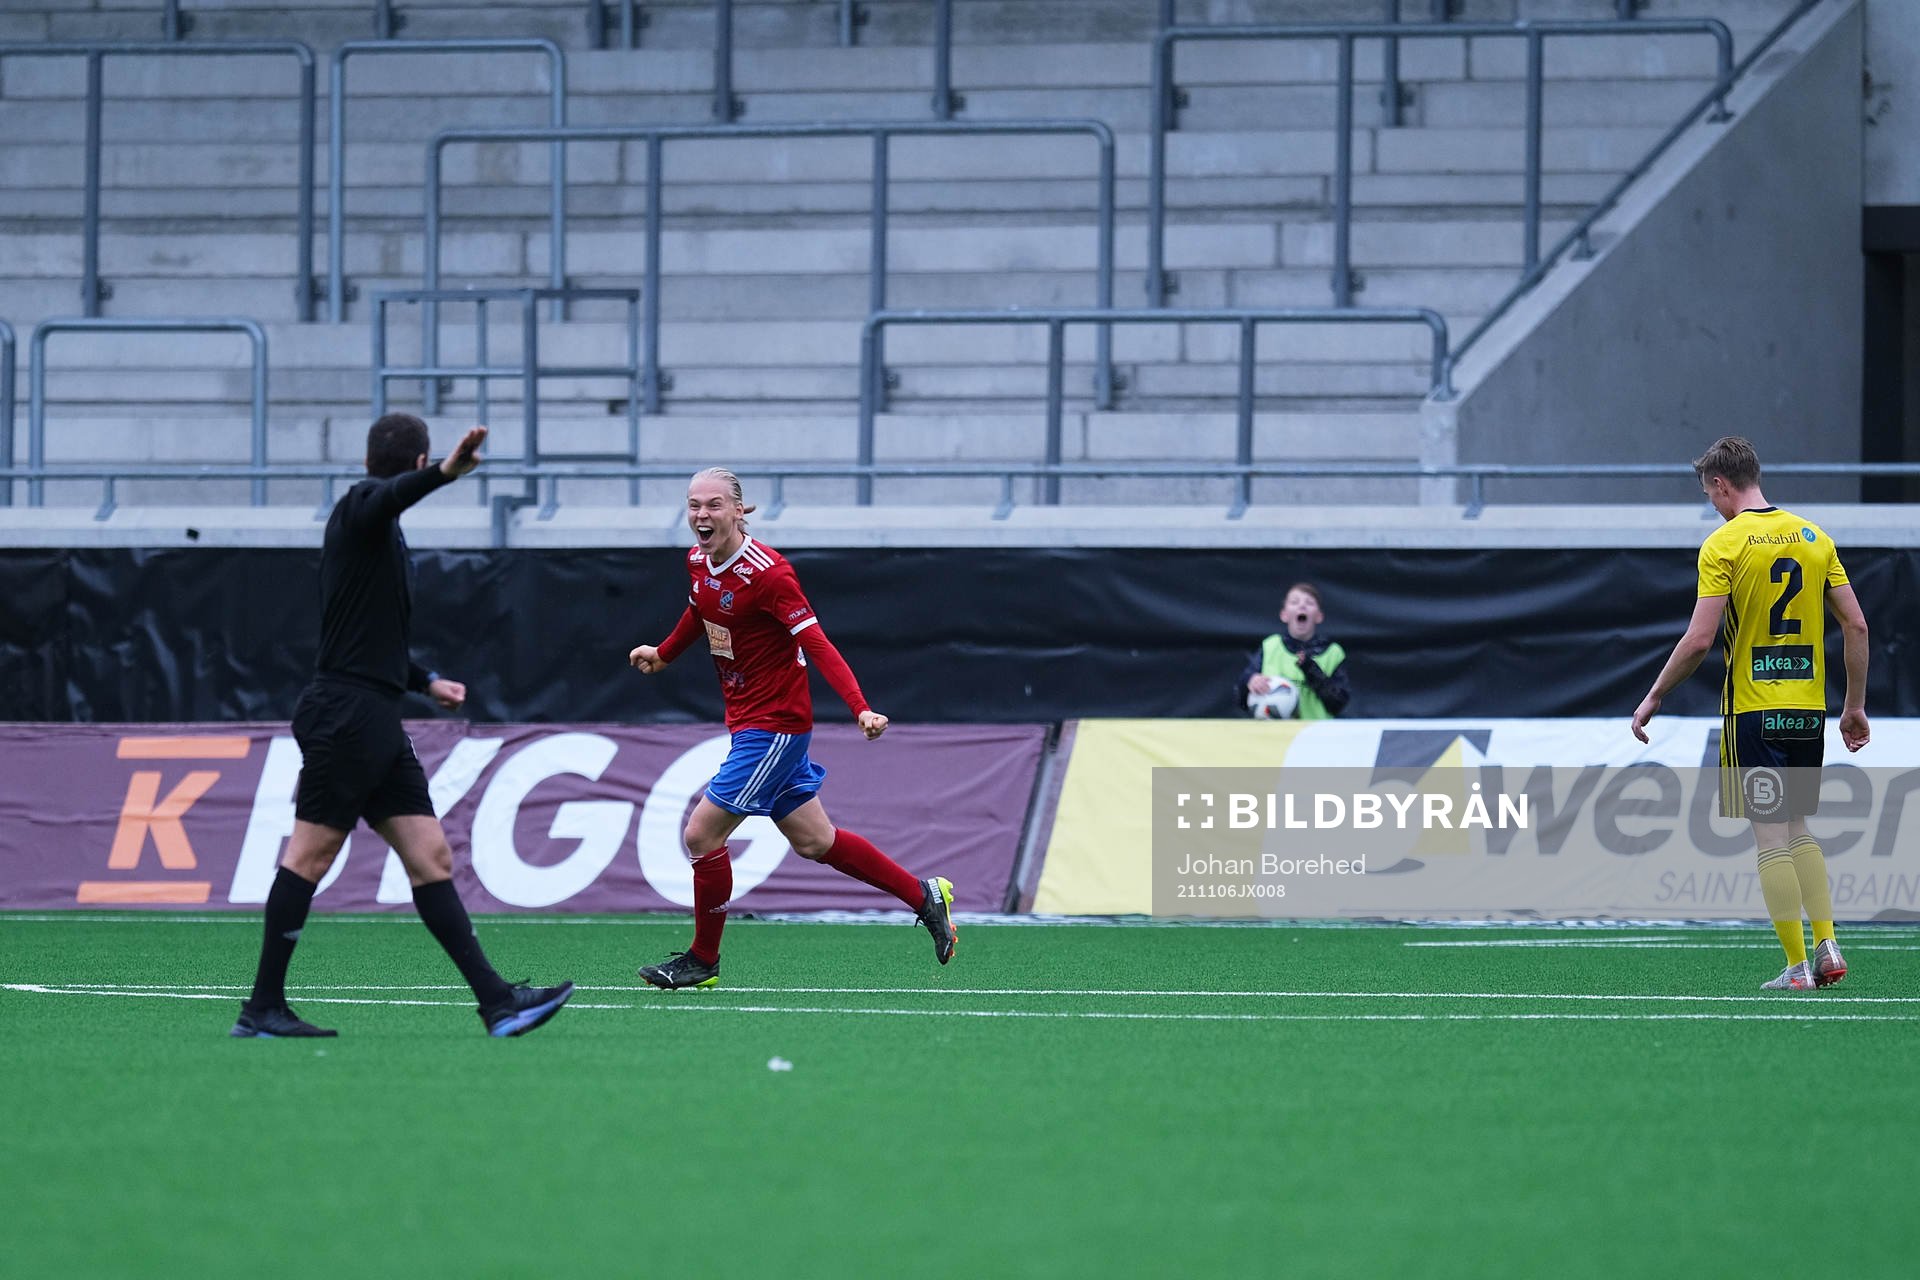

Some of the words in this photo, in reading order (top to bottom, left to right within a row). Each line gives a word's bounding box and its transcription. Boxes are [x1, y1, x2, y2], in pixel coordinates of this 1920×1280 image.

[1748, 532, 1801, 546] Backahill
[1769, 557, 1803, 636] 2
[1753, 655, 1793, 671] akea
[1764, 713, 1805, 730] akea
[108, 771, 220, 869] K
